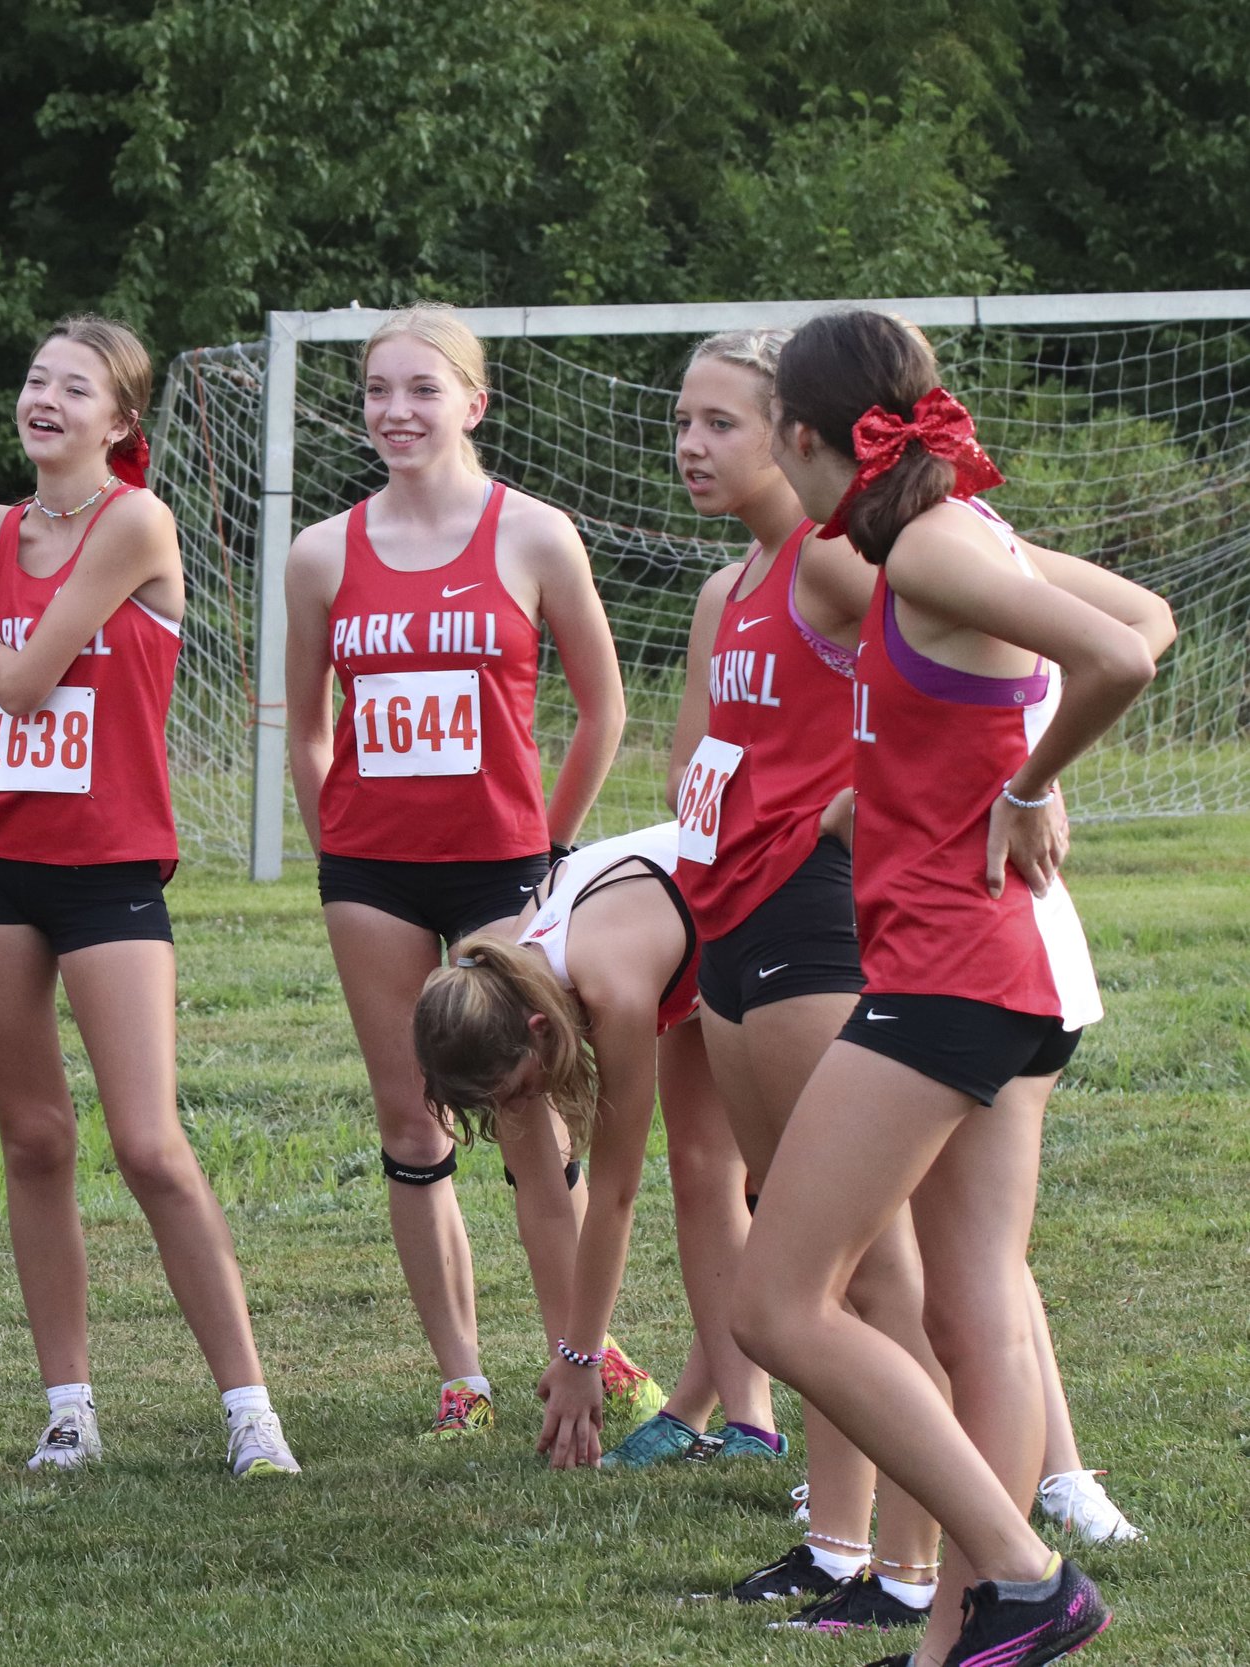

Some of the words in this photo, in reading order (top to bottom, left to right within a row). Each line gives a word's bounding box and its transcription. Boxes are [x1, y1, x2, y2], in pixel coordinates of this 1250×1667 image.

[333, 612, 414, 661] PARK
[428, 611, 502, 657] HILL
[721, 649, 782, 708] HILL
[359, 694, 478, 753] 1644
